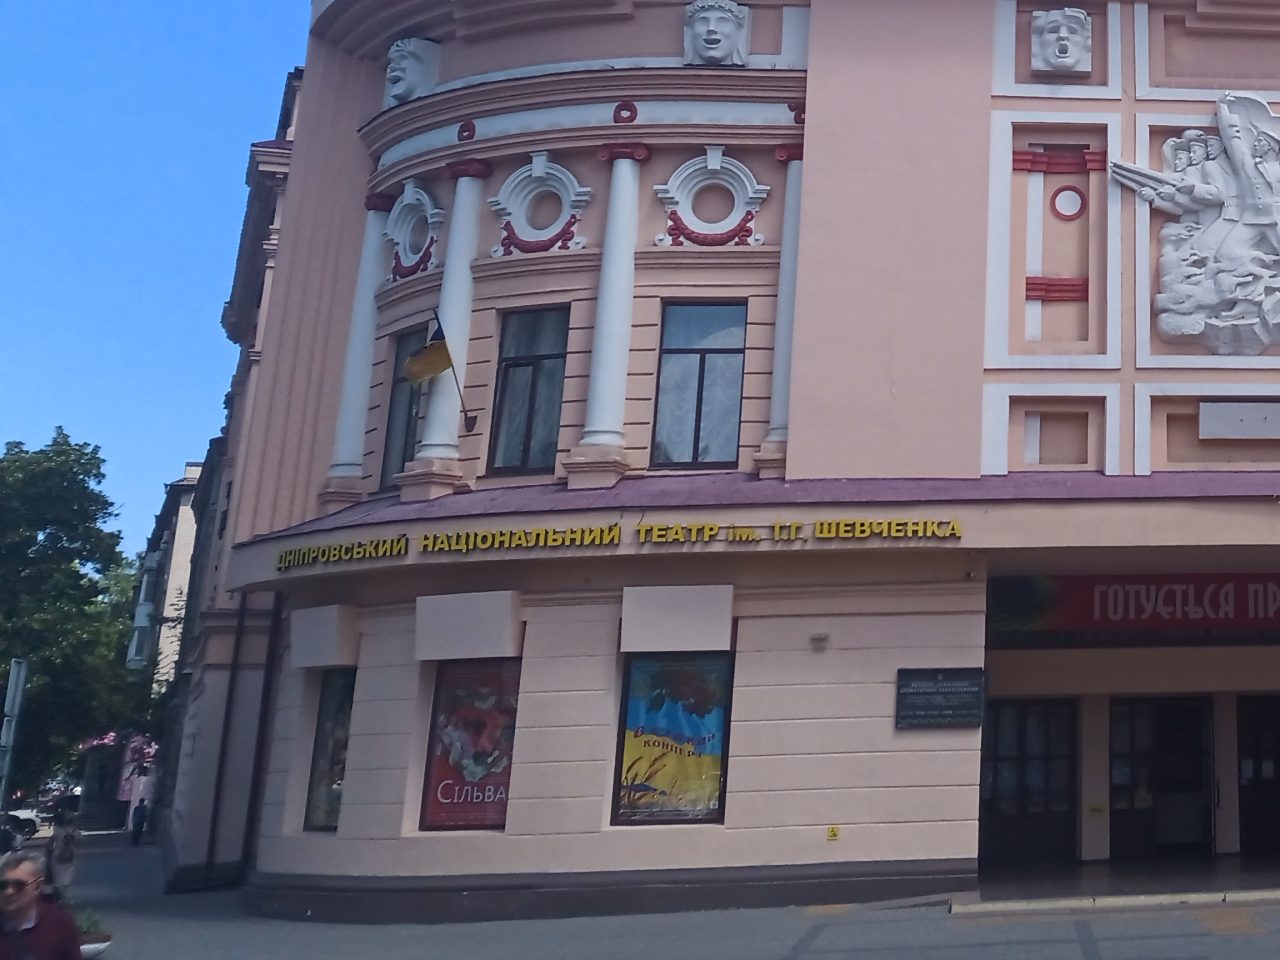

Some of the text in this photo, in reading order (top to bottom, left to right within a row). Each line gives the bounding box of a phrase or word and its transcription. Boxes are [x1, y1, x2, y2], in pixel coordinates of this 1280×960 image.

[276, 534, 408, 571] ДНІПРОВСЬКИЙ
[419, 522, 621, 553] НАЦІОНАЛЬНИЙ
[638, 524, 720, 544] ТЕАТР
[815, 519, 962, 539] ШЕВЧЕНКА
[1093, 582, 1235, 620] ГОТУЄТЬСЯ
